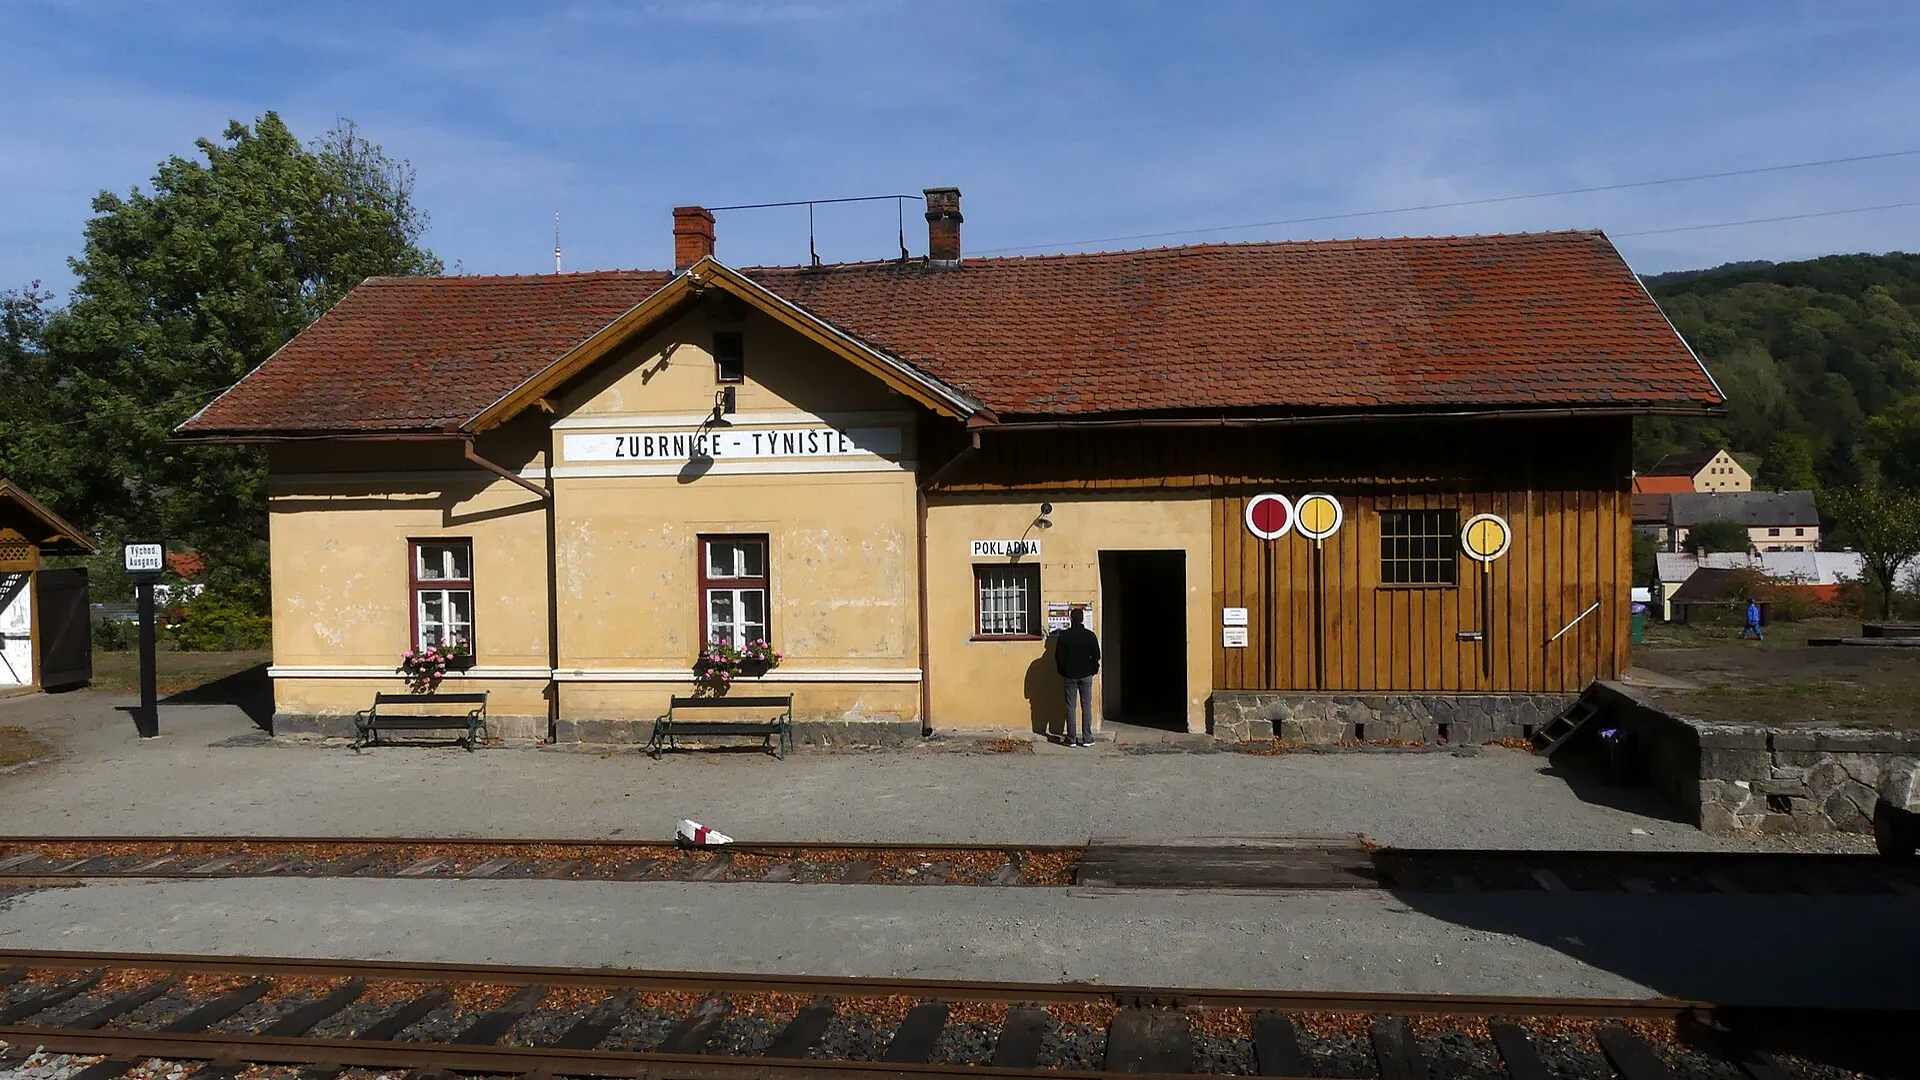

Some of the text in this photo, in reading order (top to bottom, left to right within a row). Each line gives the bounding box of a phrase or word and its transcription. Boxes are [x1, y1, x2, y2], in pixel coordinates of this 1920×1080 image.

[615, 433, 721, 458] ZUBRNICE
[752, 429, 848, 455] TÝNIŠTĚ
[974, 541, 1037, 555] POKLADNA
